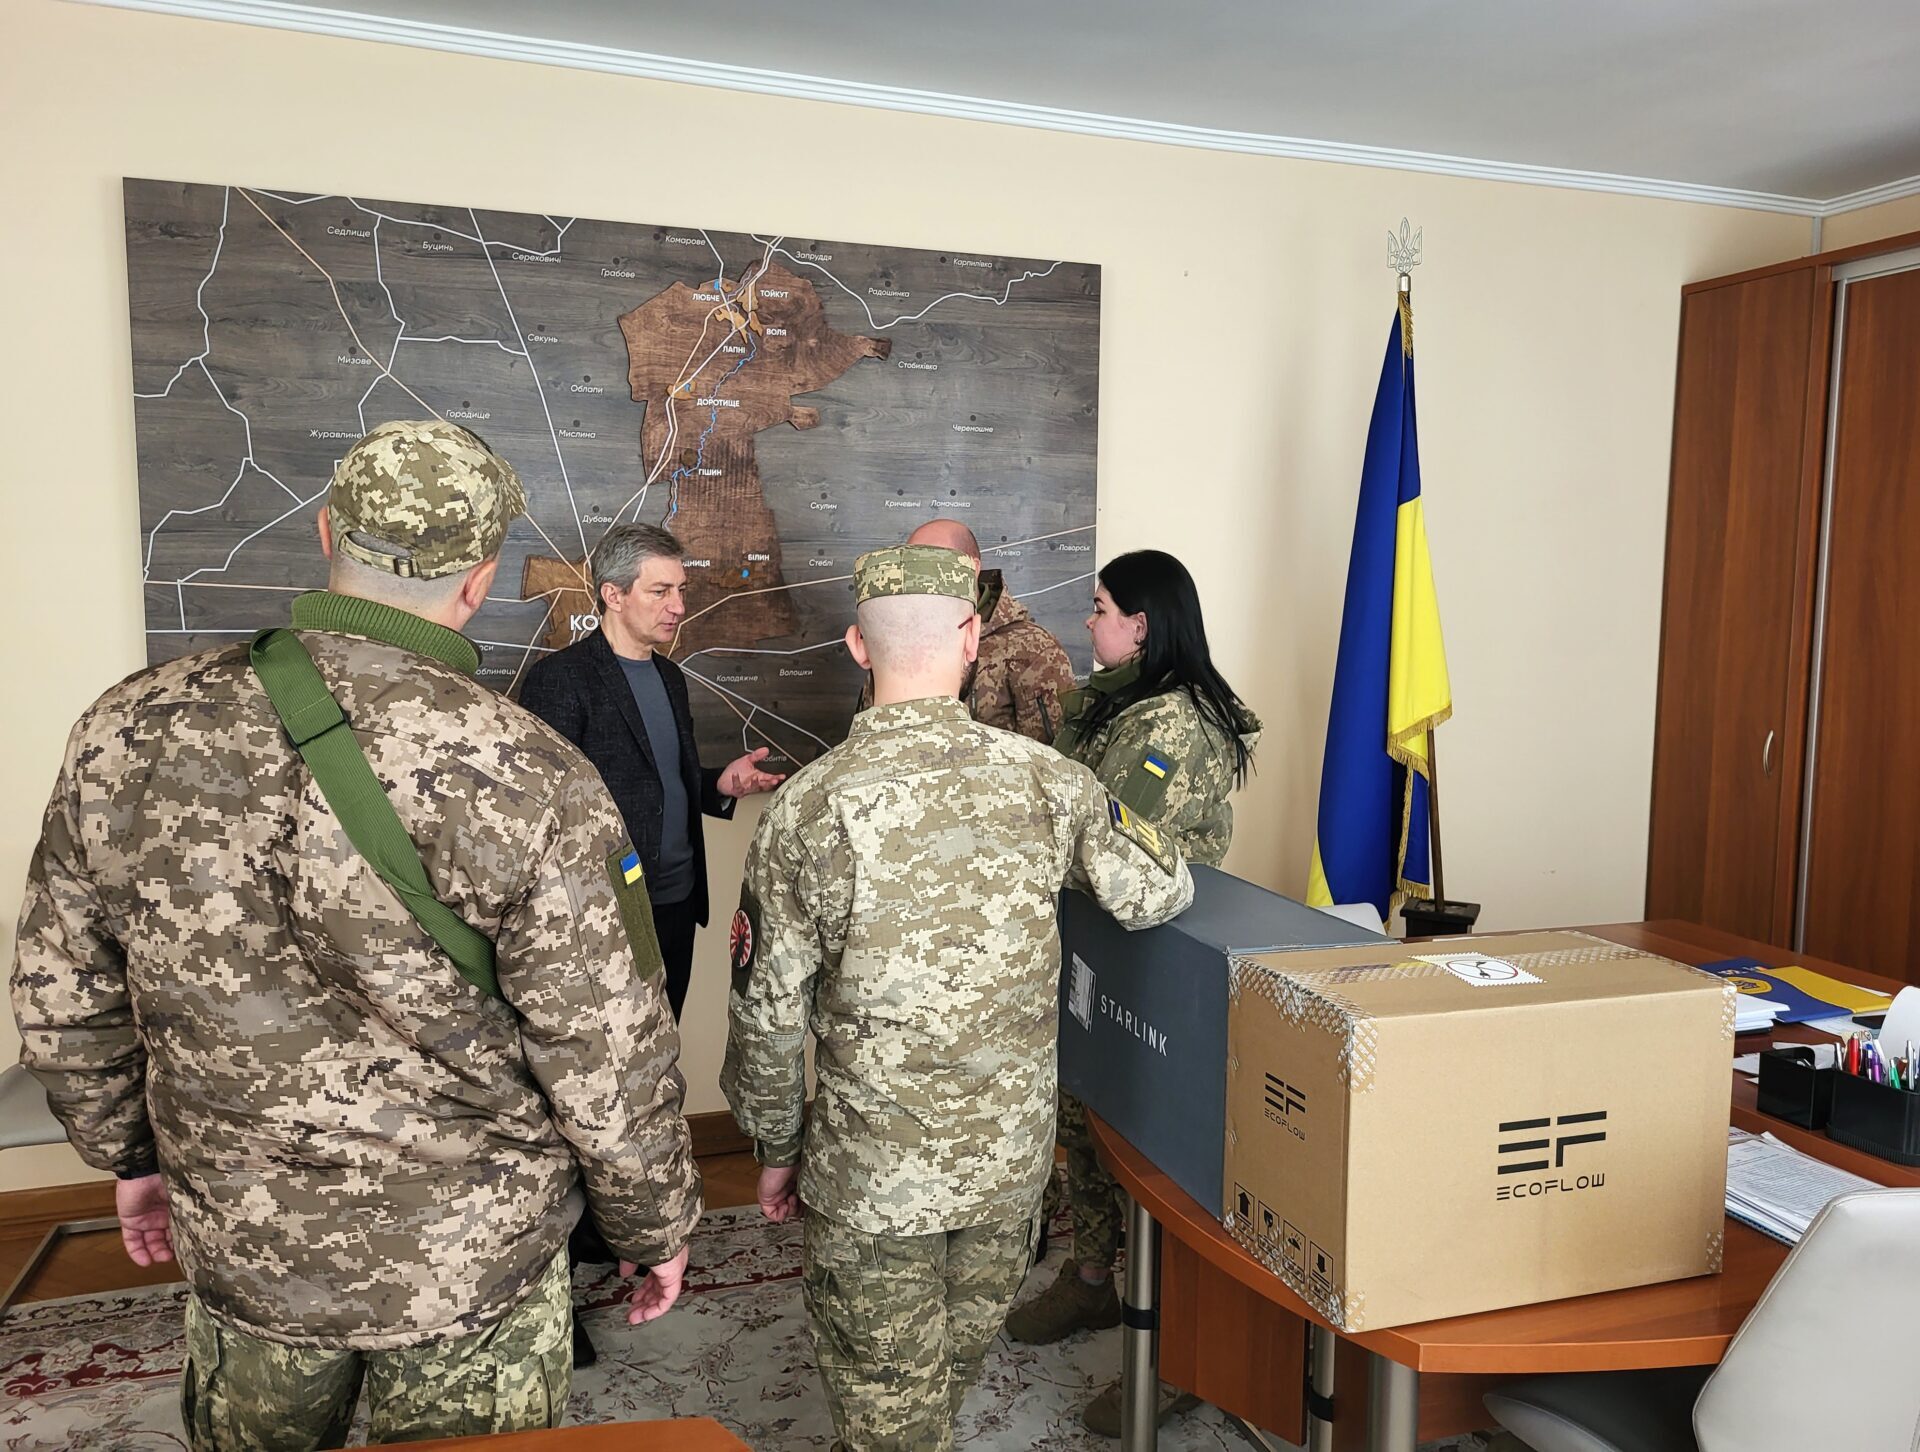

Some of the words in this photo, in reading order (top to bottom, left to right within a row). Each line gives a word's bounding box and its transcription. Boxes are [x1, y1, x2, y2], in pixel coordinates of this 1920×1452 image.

[327, 226, 371, 238] Седлище
[665, 235, 706, 246] Комарове
[422, 241, 454, 252] Буцинь
[512, 252, 562, 264] Сереховичі
[795, 250, 833, 262] Запруддя
[600, 268, 636, 279] Грабове
[692, 293, 720, 302] ЛЮБЧЕ
[760, 289, 790, 299] ТОЙКУТ
[868, 287, 910, 298] Радошинка
[527, 333, 558, 343] Секунь
[766, 328, 787, 337] ВОЛЯ
[722, 345, 746, 354] ЛАПНІ
[337, 355, 372, 366] Мизове
[696, 398, 740, 408] ДОРОТИЩЕ
[446, 409, 491, 420] Городище
[952, 423, 994, 433] Черемошне
[309, 429, 363, 440] Журавлине
[558, 429, 596, 439] Мислина
[810, 501, 838, 511] Скулин
[582, 514, 613, 525] Дубове
[682, 559, 711, 568] ДНИЦЯ
[779, 667, 813, 677] Волошки
[1101, 993, 1168, 1057] STARLINK
[1264, 1107, 1306, 1141] ECOFLOW
[1496, 1172, 1605, 1201] ECOFLOW
